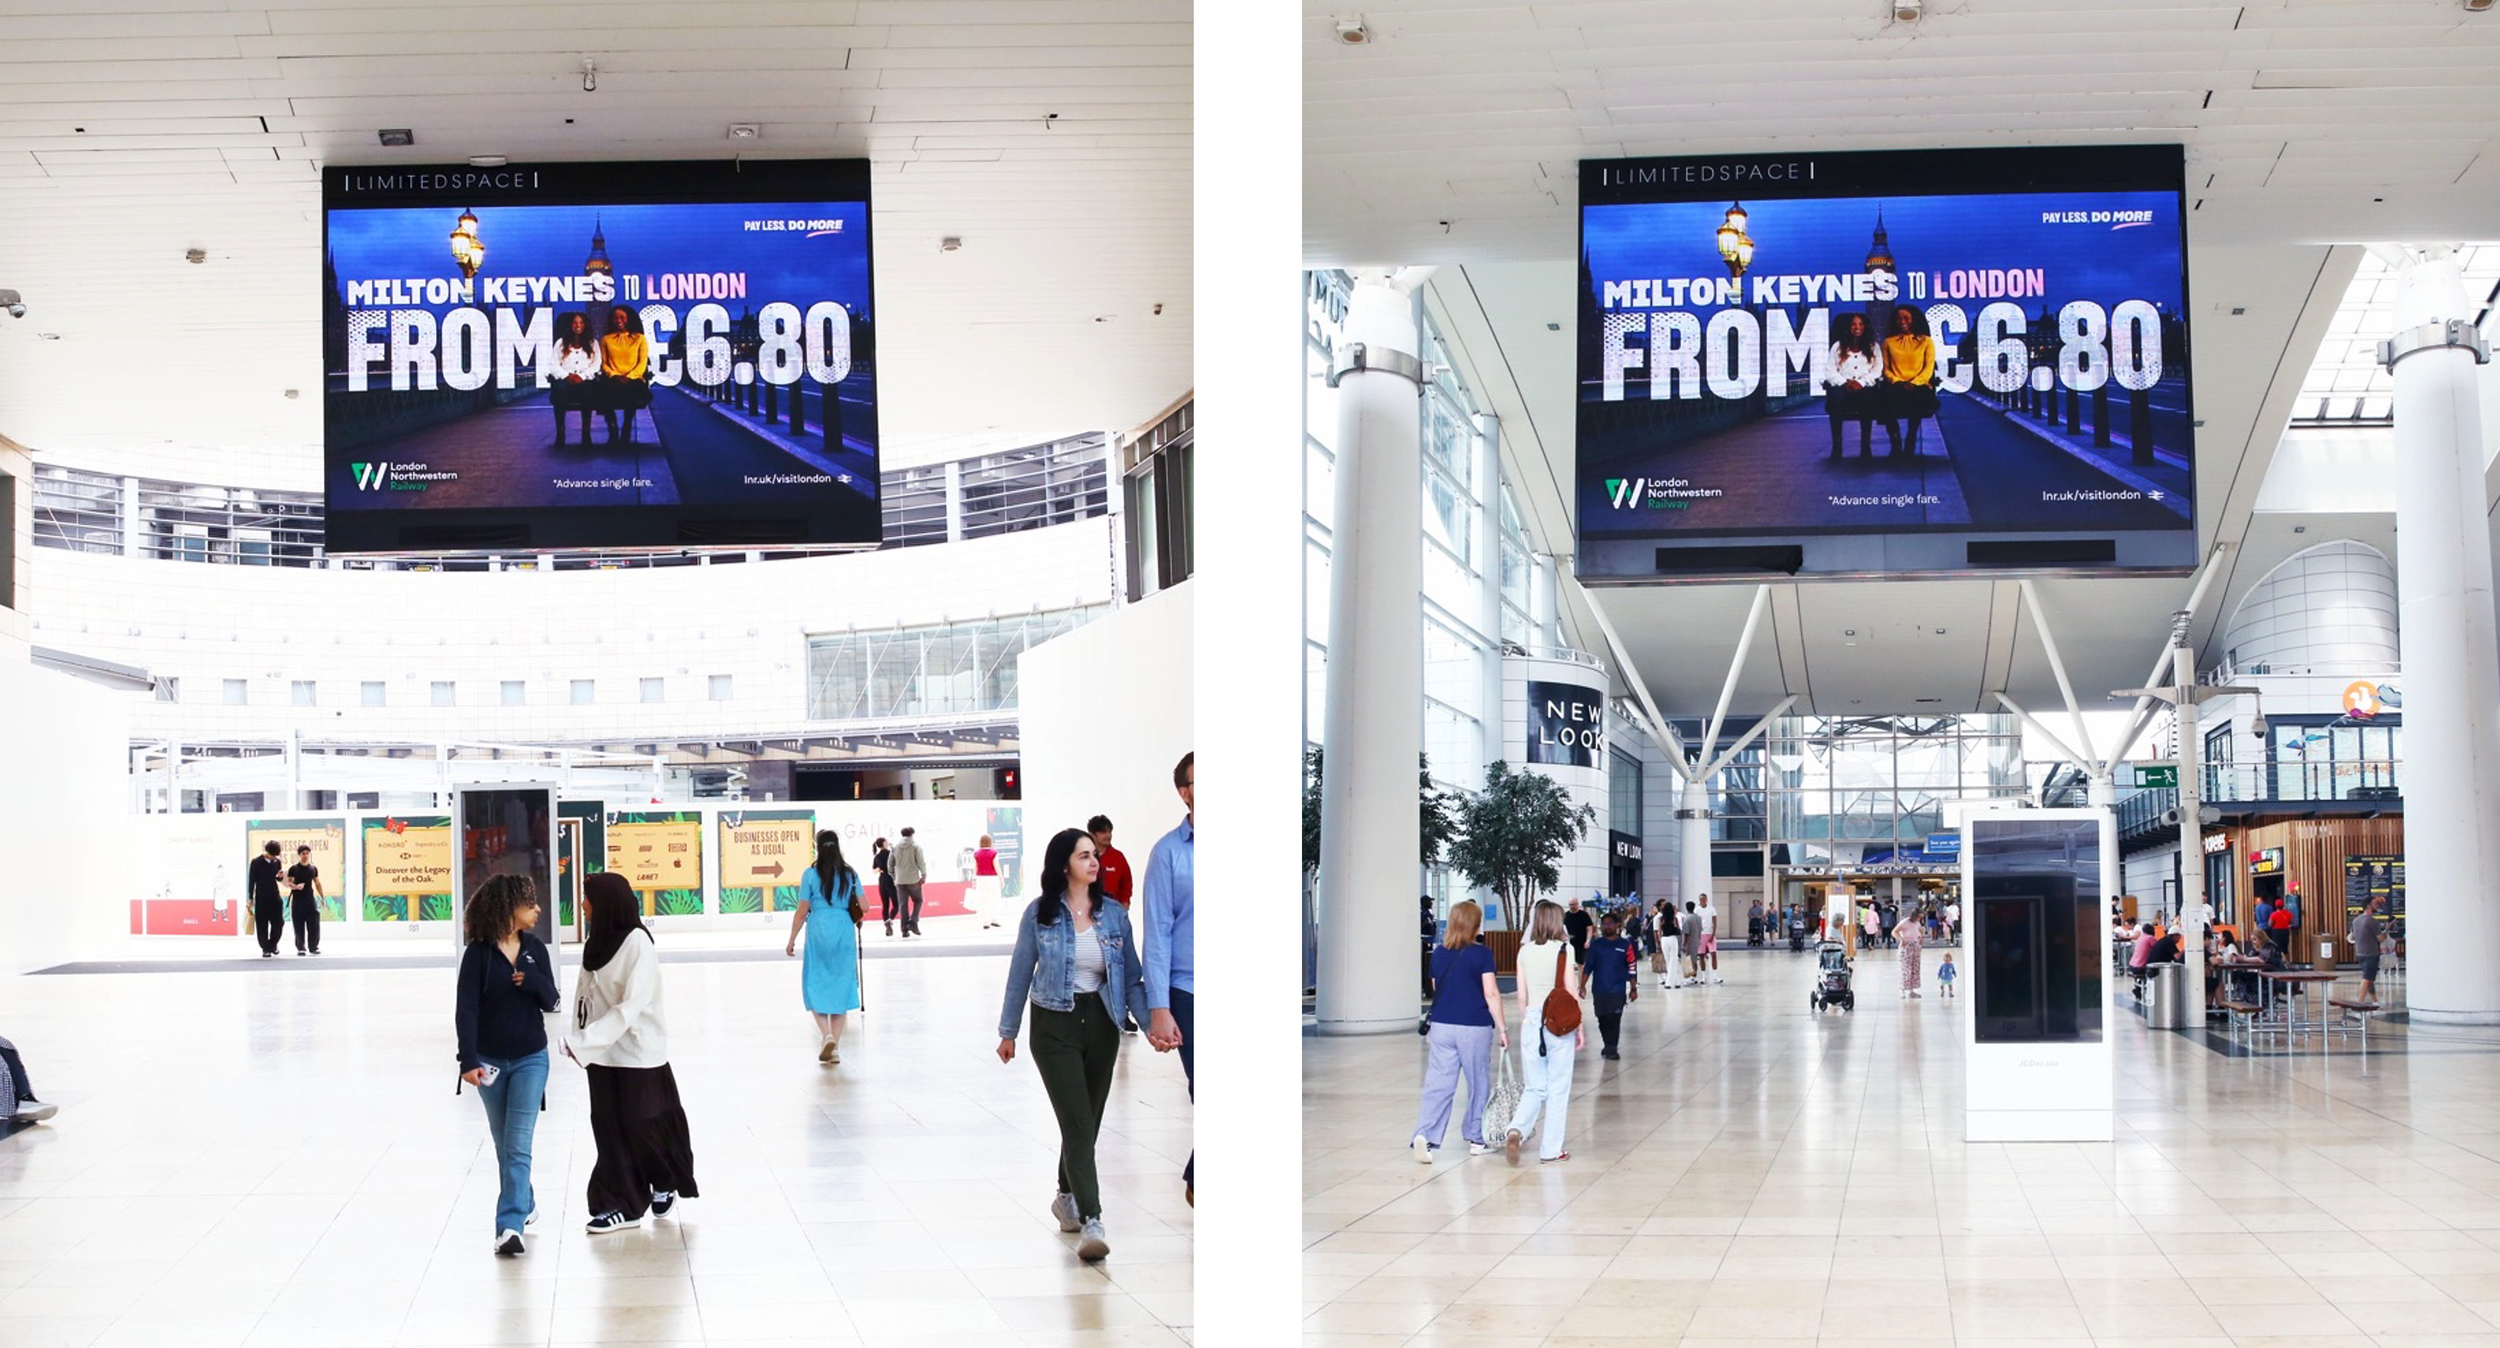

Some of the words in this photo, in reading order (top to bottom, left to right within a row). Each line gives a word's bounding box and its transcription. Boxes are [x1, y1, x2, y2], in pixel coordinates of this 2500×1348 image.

[356, 171, 525, 191] LIMITEDSPACE
[1616, 163, 1799, 186] LIMITEDSPACE
[2042, 212, 2061, 223] PAY
[2062, 211, 2090, 223] LESS,
[2091, 211, 2111, 222] DO
[2112, 210, 2153, 222] MORE
[744, 220, 761, 231] PAY
[762, 220, 787, 232] LESS,
[788, 220, 806, 231] DO
[807, 219, 844, 231] MORE
[347, 277, 474, 306] MILTON
[483, 271, 615, 304] KEYNES
[623, 274, 640, 301] TO
[646, 272, 746, 301] LONDON
[1603, 275, 1742, 309] MILTON
[1752, 268, 1899, 305] KEYNES
[1906, 271, 1926, 300] TO
[1933, 268, 2045, 300] LONDON
[347, 307, 553, 392] FROM
[1602, 306, 1829, 402] FROM
[390, 462, 427, 471] London
[390, 471, 458, 481] Northwestern
[744, 473, 832, 485] lnr.uk/visitlondon
[1648, 477, 1689, 487] London
[390, 481, 427, 491] Railway
[600, 478, 630, 490] single
[632, 477, 653, 488] fare.
[1648, 487, 1722, 498] Northwestern
[2042, 489, 2141, 502] lnr.uk/visitlondon
[1648, 499, 1689, 510] Railway
[1881, 494, 1914, 508] single
[1916, 493, 1941, 504] fare.
[1547, 700, 1601, 724] NEW
[1539, 725, 1604, 751] LOOK
[734, 831, 779, 843] BUSINESSES
[781, 831, 799, 841] OPEN
[309, 839, 329, 851] OPEN
[751, 844, 760, 855] AS
[763, 844, 786, 855] USUAL
[1616, 841, 1628, 857] NEW
[376, 866, 408, 874] Discover
[410, 866, 423, 874] the
[424, 866, 451, 875] Legacy
[392, 875, 400, 883] of
[416, 875, 434, 883] Oak.
